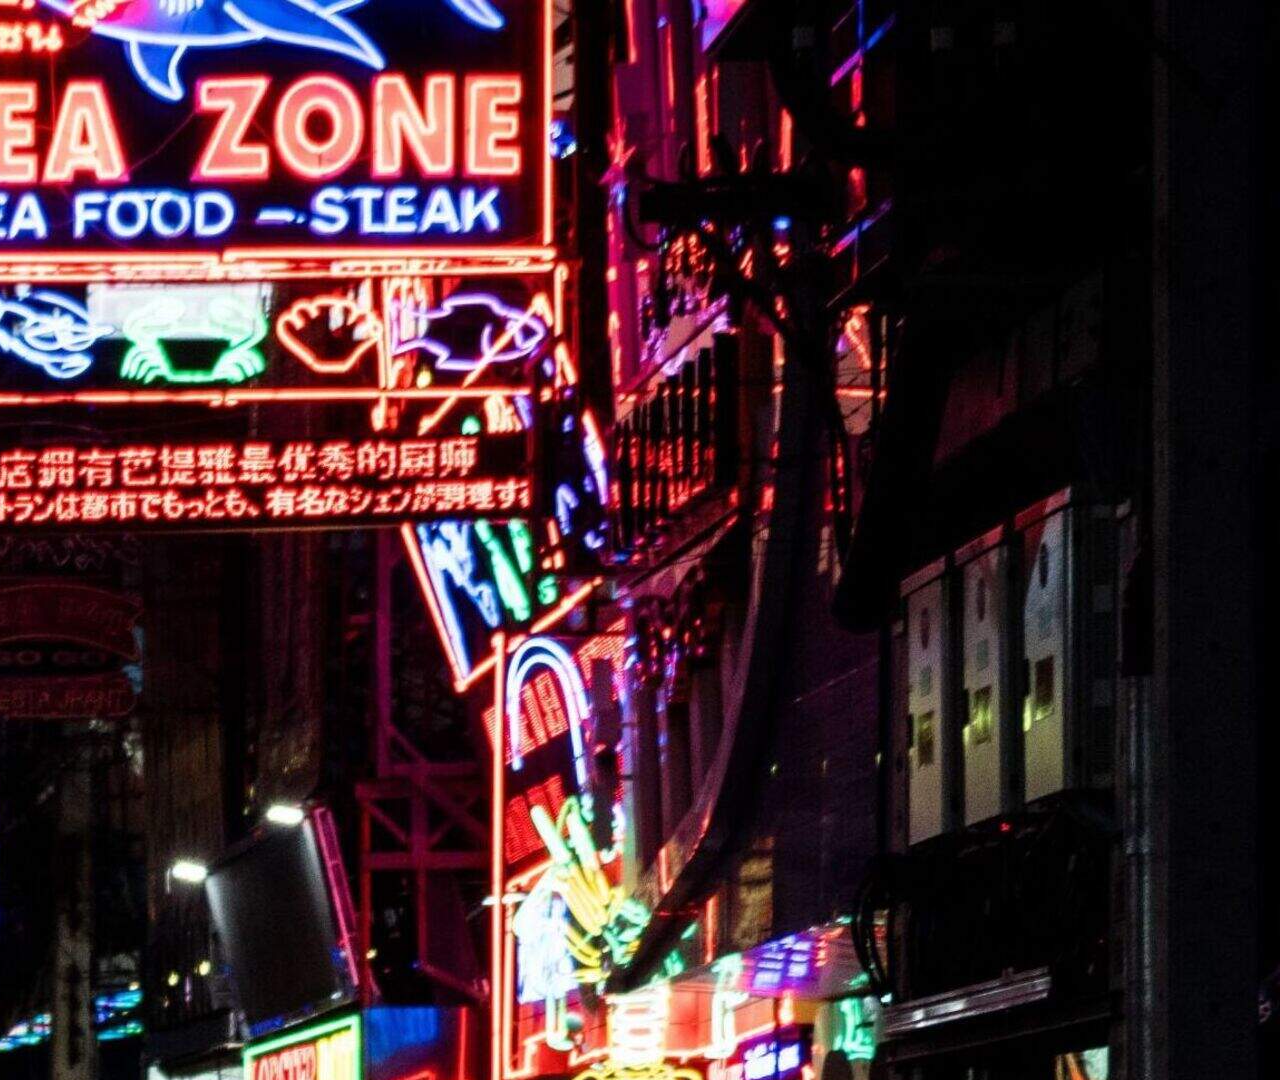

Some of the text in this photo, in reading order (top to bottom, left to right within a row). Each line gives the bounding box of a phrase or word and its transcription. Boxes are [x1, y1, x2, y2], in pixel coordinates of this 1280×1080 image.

[196, 75, 524, 178] ZONE
[74, 190, 236, 239] FOOD
[306, 184, 502, 236] STEAK
